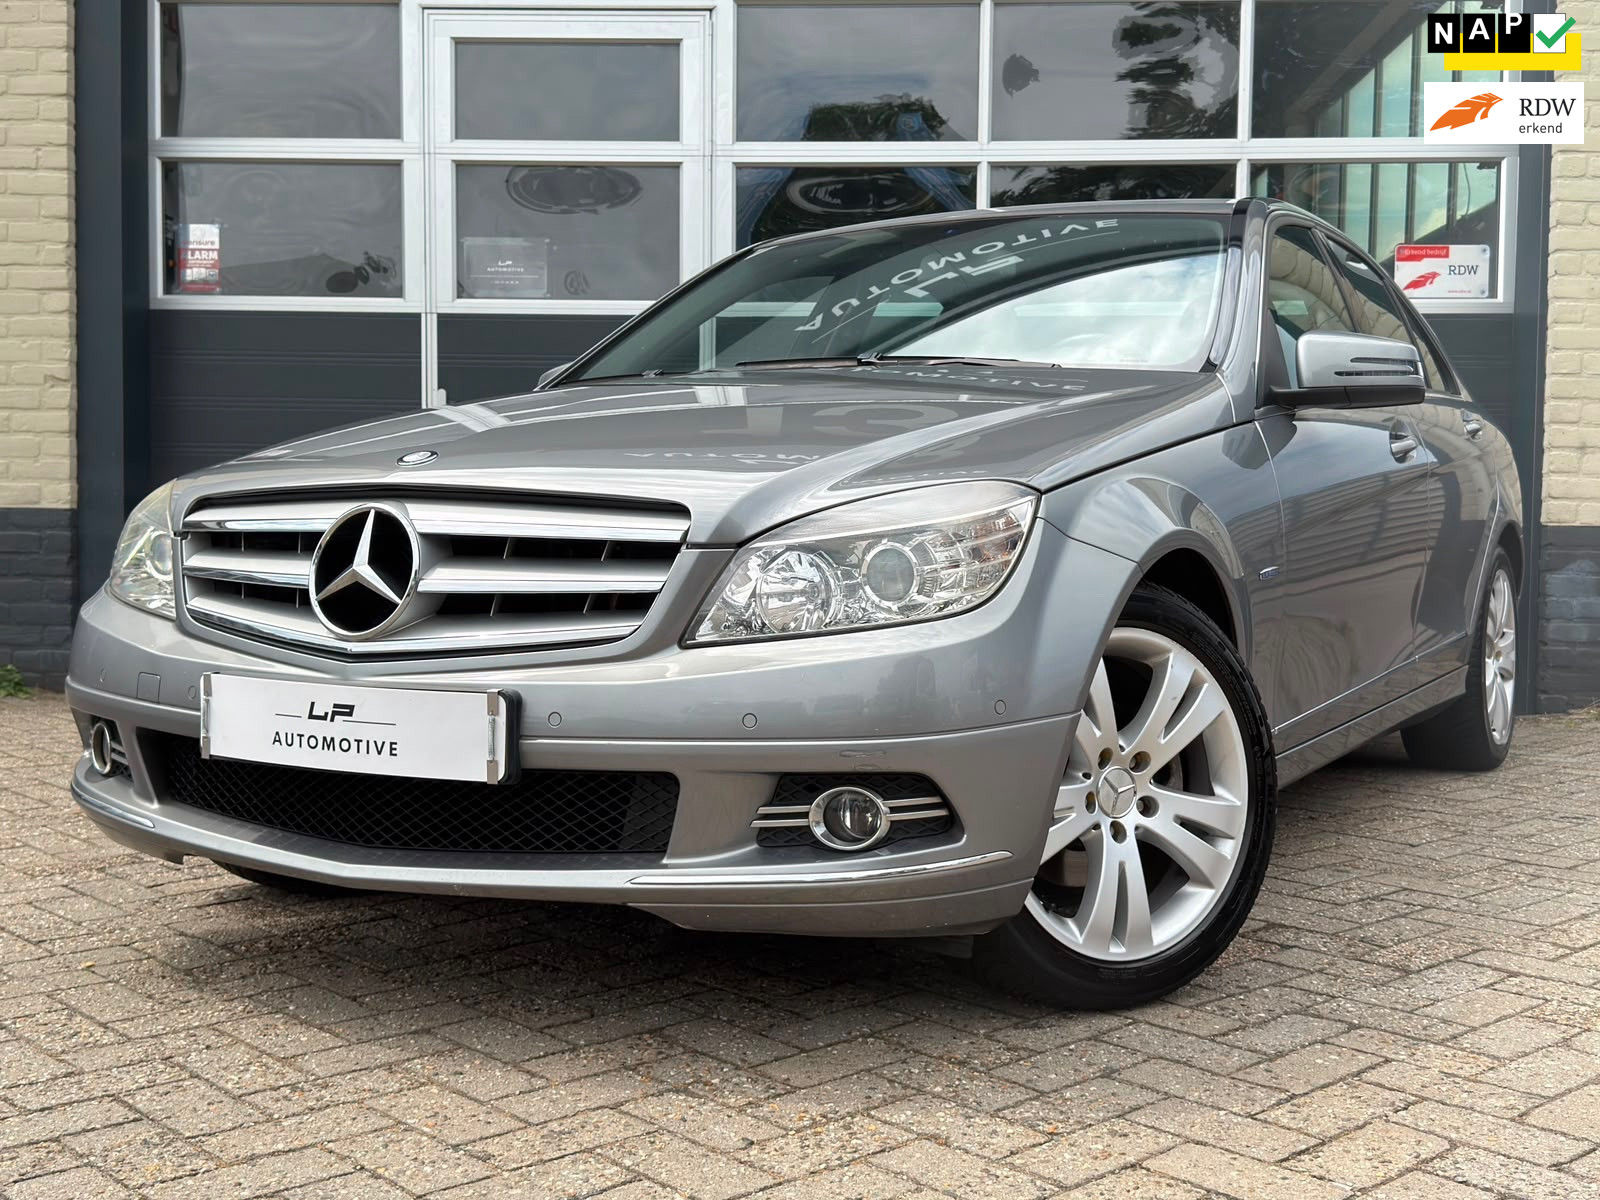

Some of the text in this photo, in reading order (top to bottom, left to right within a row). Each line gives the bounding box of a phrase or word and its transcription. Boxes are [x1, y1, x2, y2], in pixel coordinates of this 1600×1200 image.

[1448, 264, 1479, 276] RDW
[307, 701, 355, 722] LP
[272, 731, 398, 757] AUTOMOTIVE
